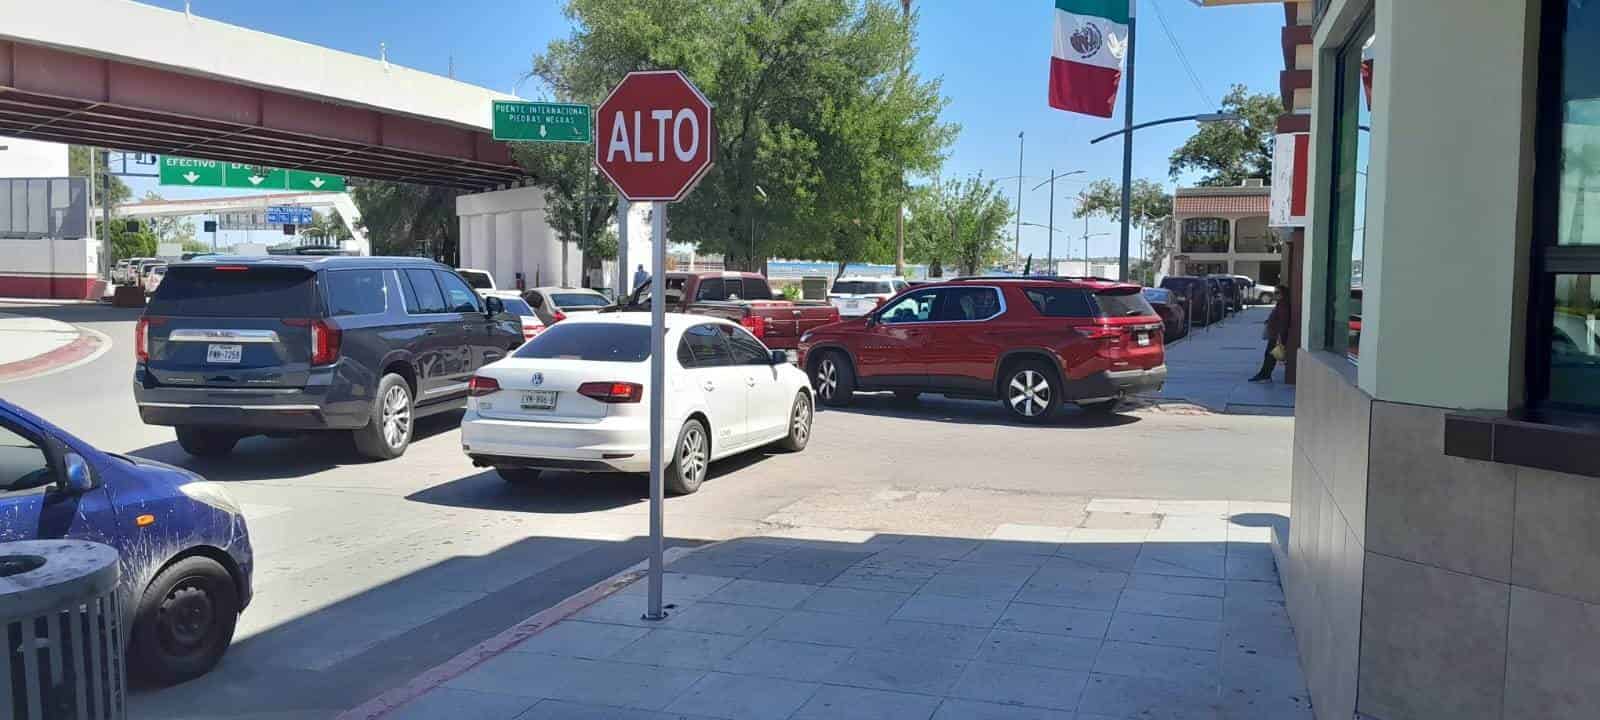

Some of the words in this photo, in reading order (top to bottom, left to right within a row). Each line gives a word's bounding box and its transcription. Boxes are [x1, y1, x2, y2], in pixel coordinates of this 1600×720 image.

[495, 104, 526, 113] PUENTE
[529, 105, 587, 116] INTERNACIONAL
[509, 114, 541, 122] PIEDRAS
[545, 116, 575, 124] NEGRAS
[606, 108, 700, 162] ALTO
[166, 158, 216, 169] EFECTIVO
